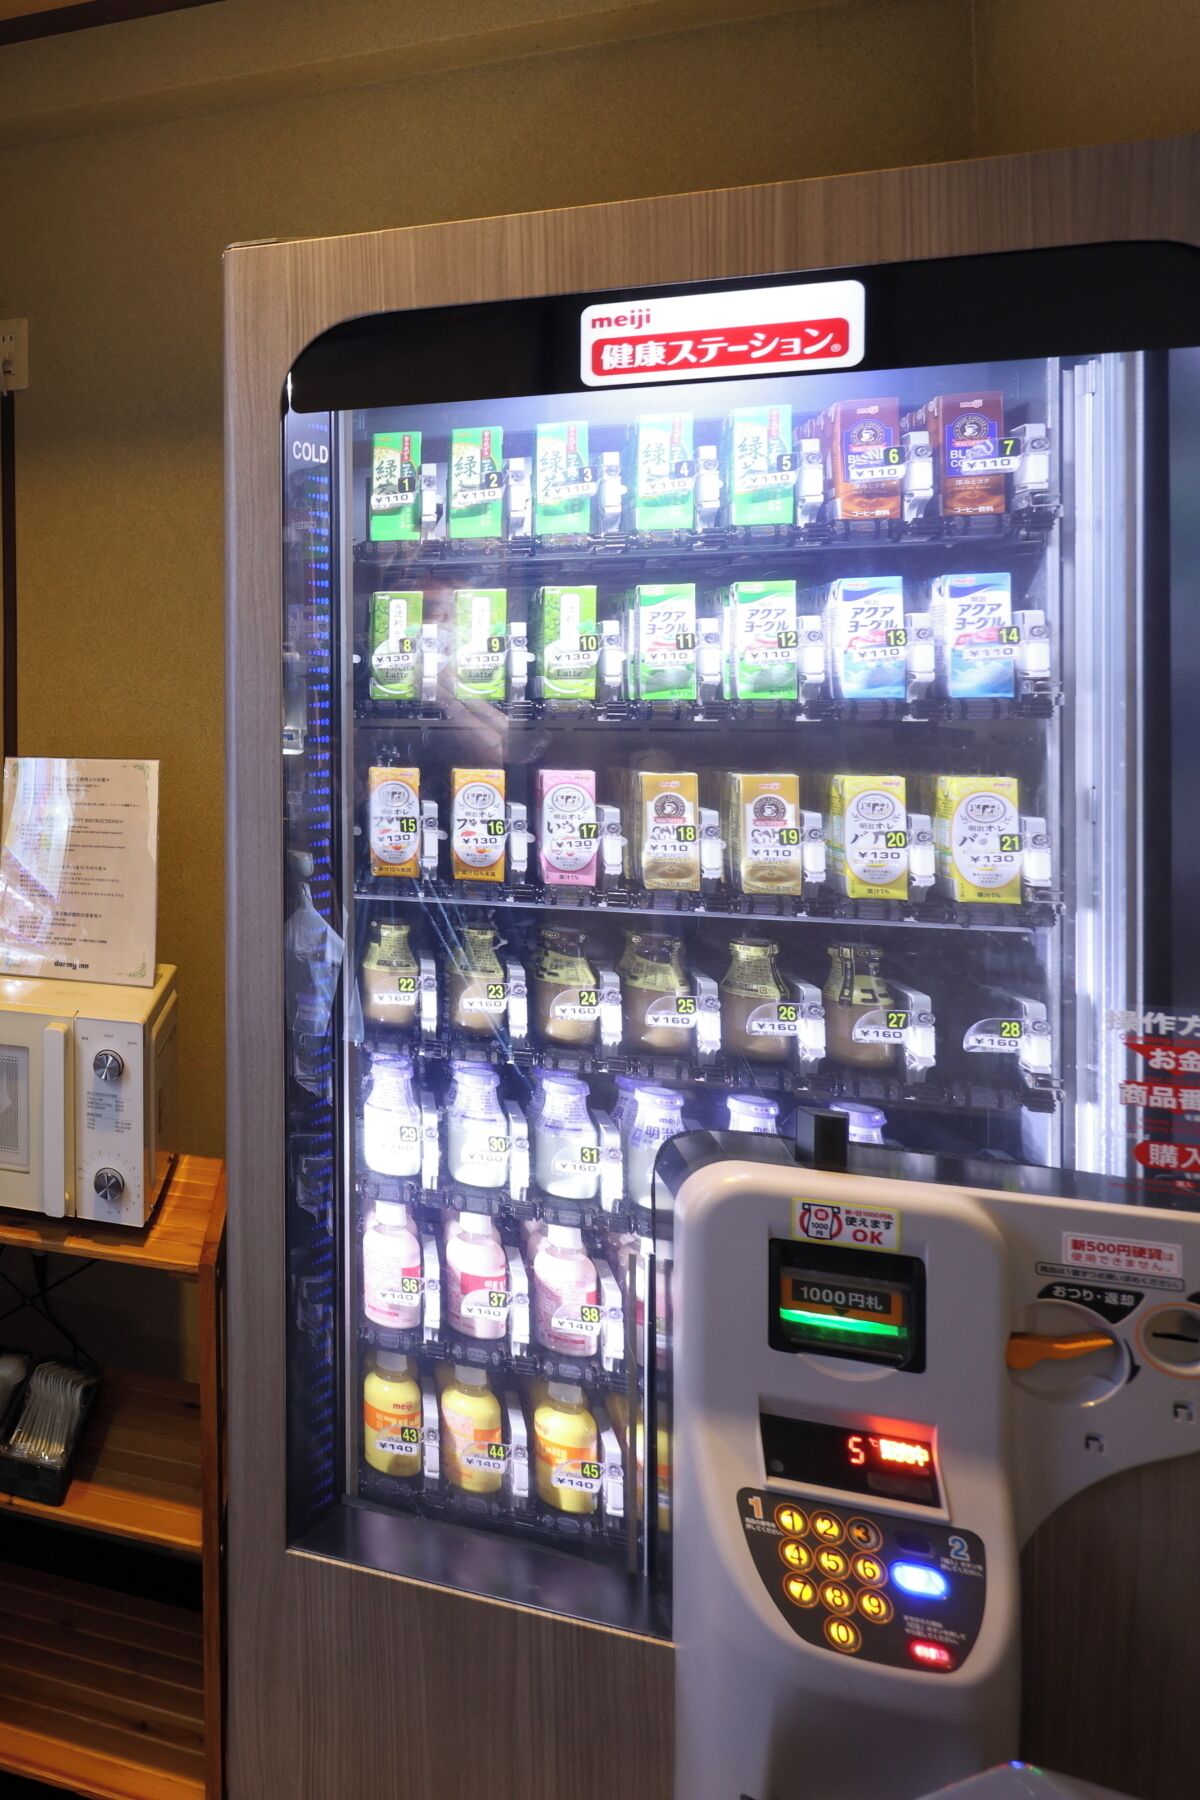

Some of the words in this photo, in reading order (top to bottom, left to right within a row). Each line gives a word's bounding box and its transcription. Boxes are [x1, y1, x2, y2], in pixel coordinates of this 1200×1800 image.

[591, 308, 650, 329] meiji
[292, 441, 328, 464] COLD
[1004, 440, 1014, 455] 7
[782, 456, 791, 470] 5
[889, 449, 898, 463] 6
[584, 468, 592, 481] 3
[680, 462, 688, 476] 4
[403, 478, 409, 491] 1
[490, 474, 498, 487] 2
[649, 611, 686, 622] アクア
[747, 608, 786, 620] アクア
[851, 606, 895, 619] アクア
[958, 603, 1002, 616] アクア
[677, 634, 693, 648] 11
[778, 632, 797, 648] 12
[888, 630, 906, 645] 13
[1000, 627, 1019, 643] 14
[404, 639, 411, 652] 8
[491, 638, 500, 651] 9
[580, 637, 597, 650] 10
[401, 819, 415, 832] 15
[489, 821, 503, 834] 16
[581, 825, 596, 837] 17
[678, 827, 694, 841] 18
[780, 831, 798, 844] 19
[887, 833, 905, 846] 20
[1002, 836, 1019, 850] 21
[54, 960, 77, 971] dormy
[400, 978, 414, 991] 22
[488, 985, 503, 998] 23
[581, 992, 596, 1005] 24
[678, 1000, 694, 1013] 25
[779, 1006, 796, 1020] 26
[888, 1013, 905, 1027] 27
[1002, 1022, 1020, 1036] 28
[401, 1128, 416, 1141] 29
[490, 1138, 506, 1151] 30
[582, 1148, 598, 1162] 31
[844, 1216, 894, 1231] 使えます
[852, 1229, 883, 1245] OK
[403, 1279, 418, 1293] 36
[490, 1293, 506, 1307] 37
[800, 1286, 883, 1311] 1000円札
[1053, 1285, 1135, 1306] おつり・返却
[582, 1308, 598, 1322] 38
[392, 1402, 413, 1412] meiji
[402, 1428, 417, 1442] 43
[489, 1445, 504, 1458] 44
[848, 1436, 865, 1465] 5
[583, 1463, 599, 1477] 45
[748, 1496, 763, 1519] 1
[789, 1511, 796, 1531] 1
[822, 1518, 835, 1537] 2
[856, 1525, 871, 1543] 3
[949, 1536, 970, 1561] 2
[789, 1546, 803, 1566] 4
[826, 1554, 839, 1572] 5
[863, 1560, 876, 1579] 6
[791, 1580, 806, 1600] 7
[831, 1588, 844, 1607] 8
[867, 1595, 882, 1615] 9
[836, 1622, 849, 1644] 0
